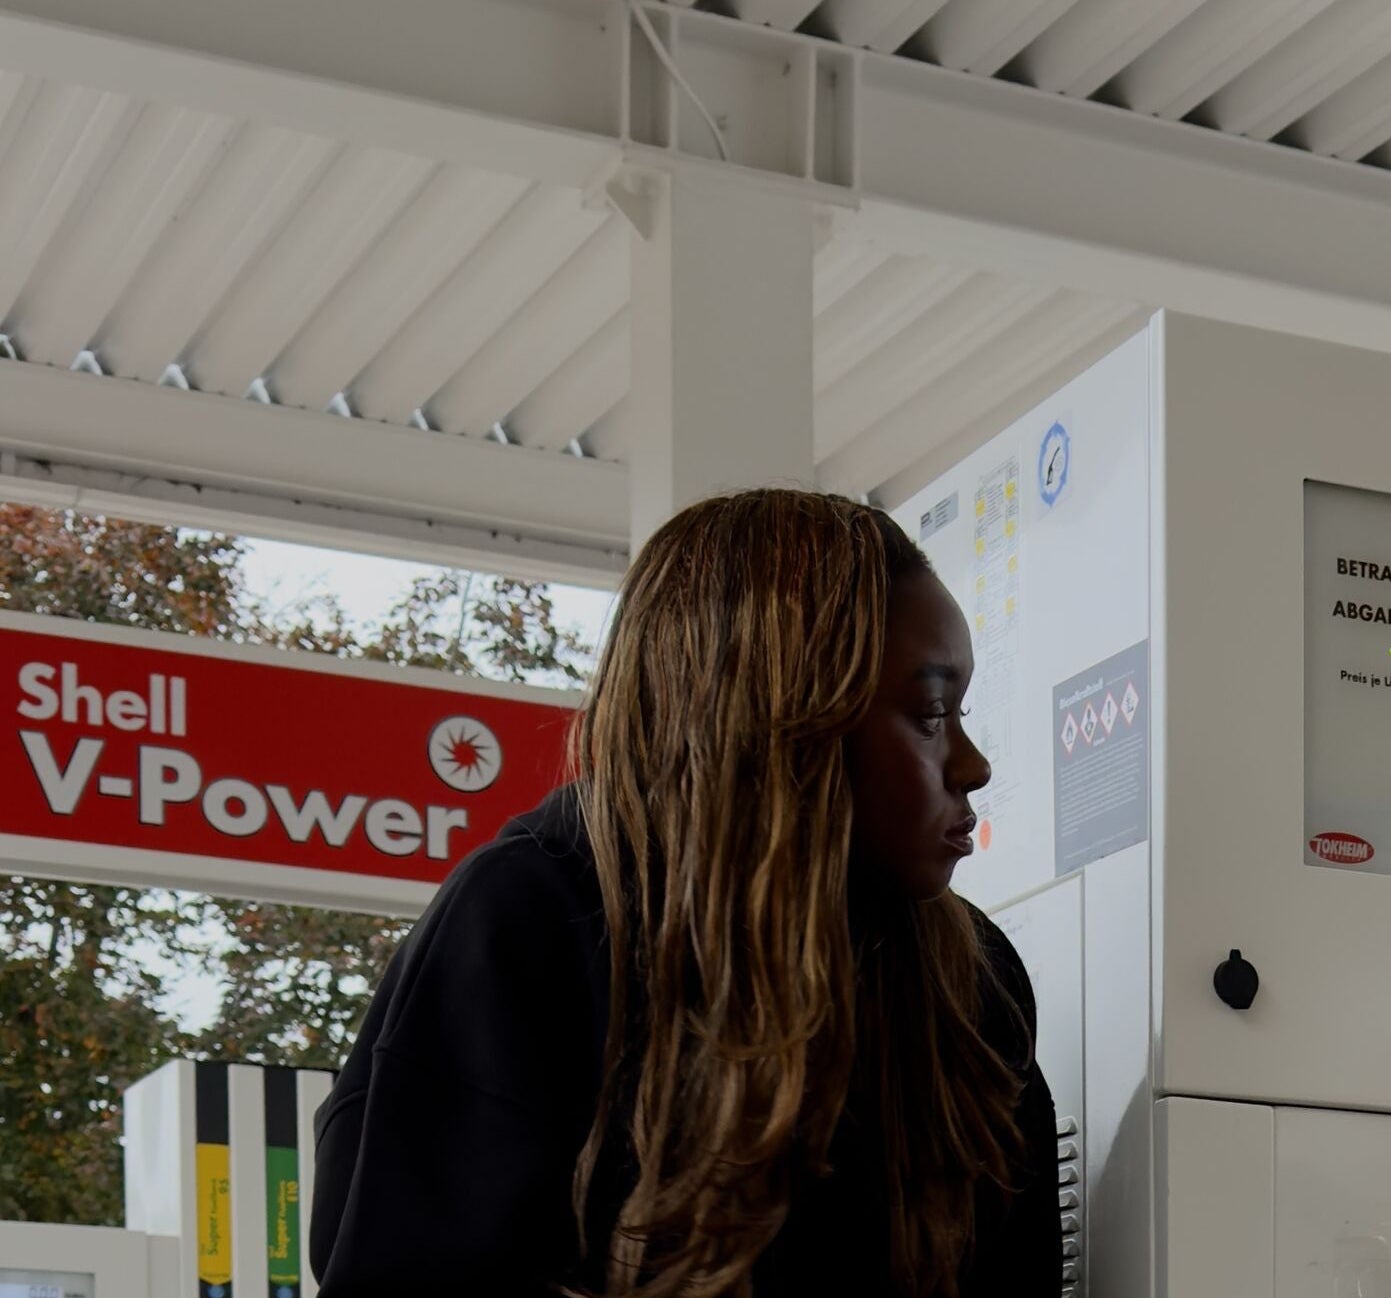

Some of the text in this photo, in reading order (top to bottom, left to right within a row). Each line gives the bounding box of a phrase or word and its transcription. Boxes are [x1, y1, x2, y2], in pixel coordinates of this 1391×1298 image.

[17, 661, 187, 738] Shell
[1340, 669, 1369, 685] Preis
[1370, 675, 1382, 688] je
[18, 730, 469, 861] V-Power
